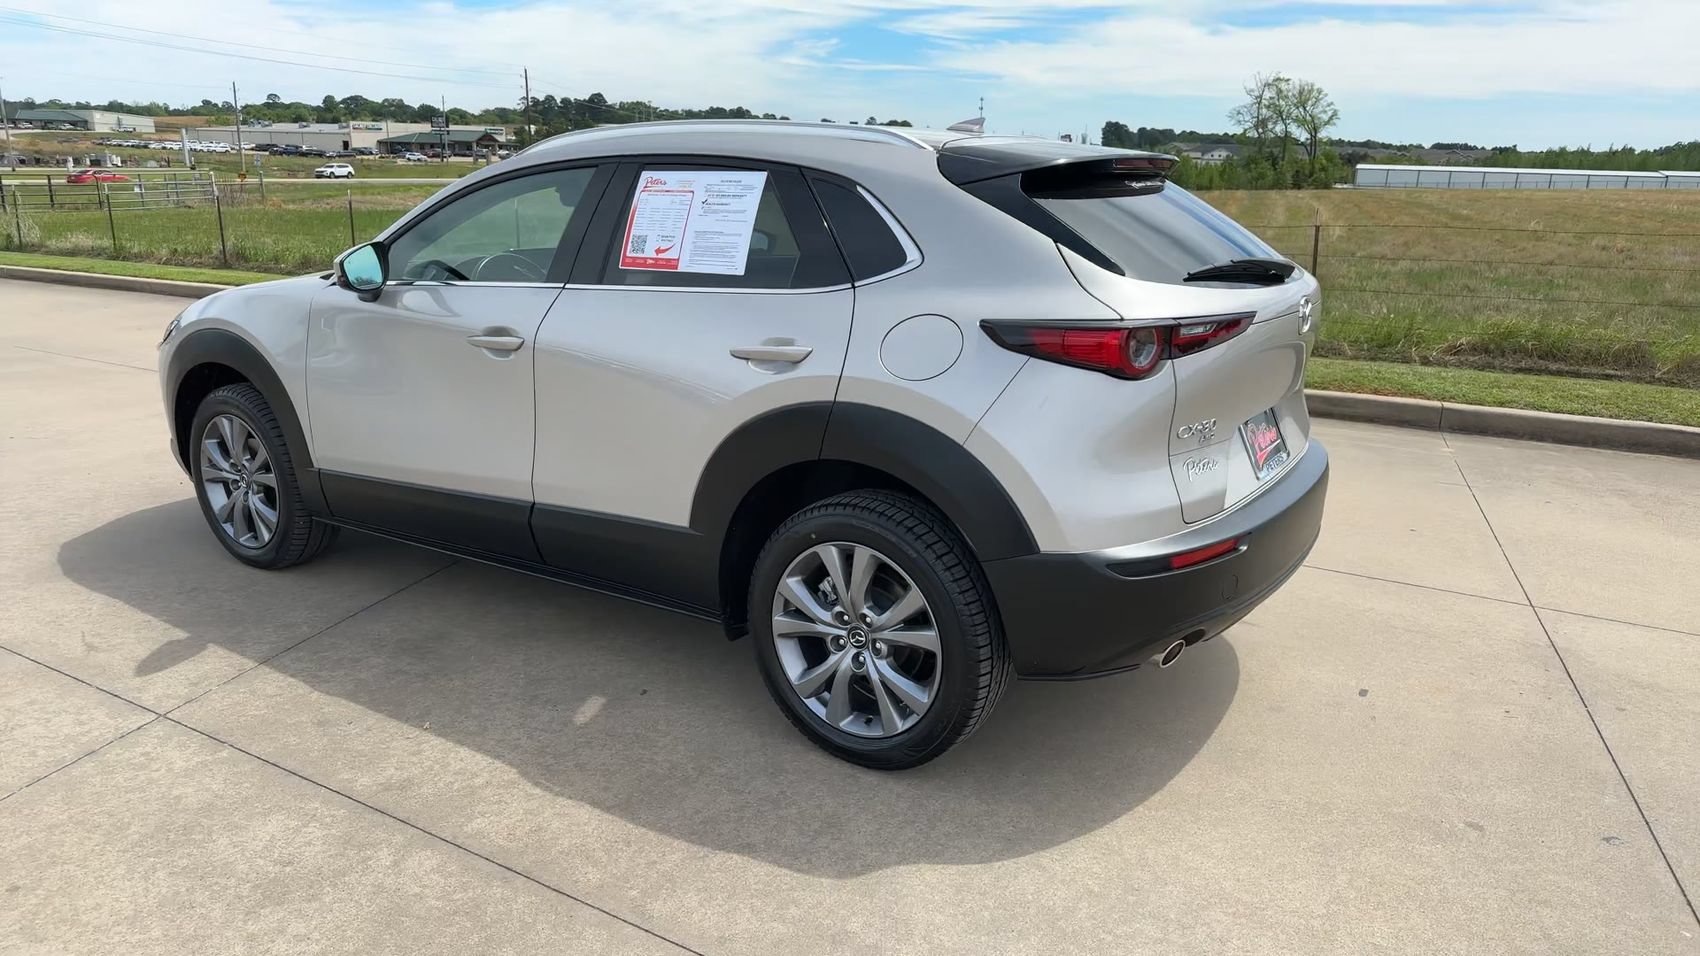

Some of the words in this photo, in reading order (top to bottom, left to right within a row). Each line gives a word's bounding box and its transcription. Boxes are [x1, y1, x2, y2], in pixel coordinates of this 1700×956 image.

[644, 176, 667, 188] Peters
[1177, 418, 1217, 439] CX-30
[1183, 457, 1218, 482] Peters
